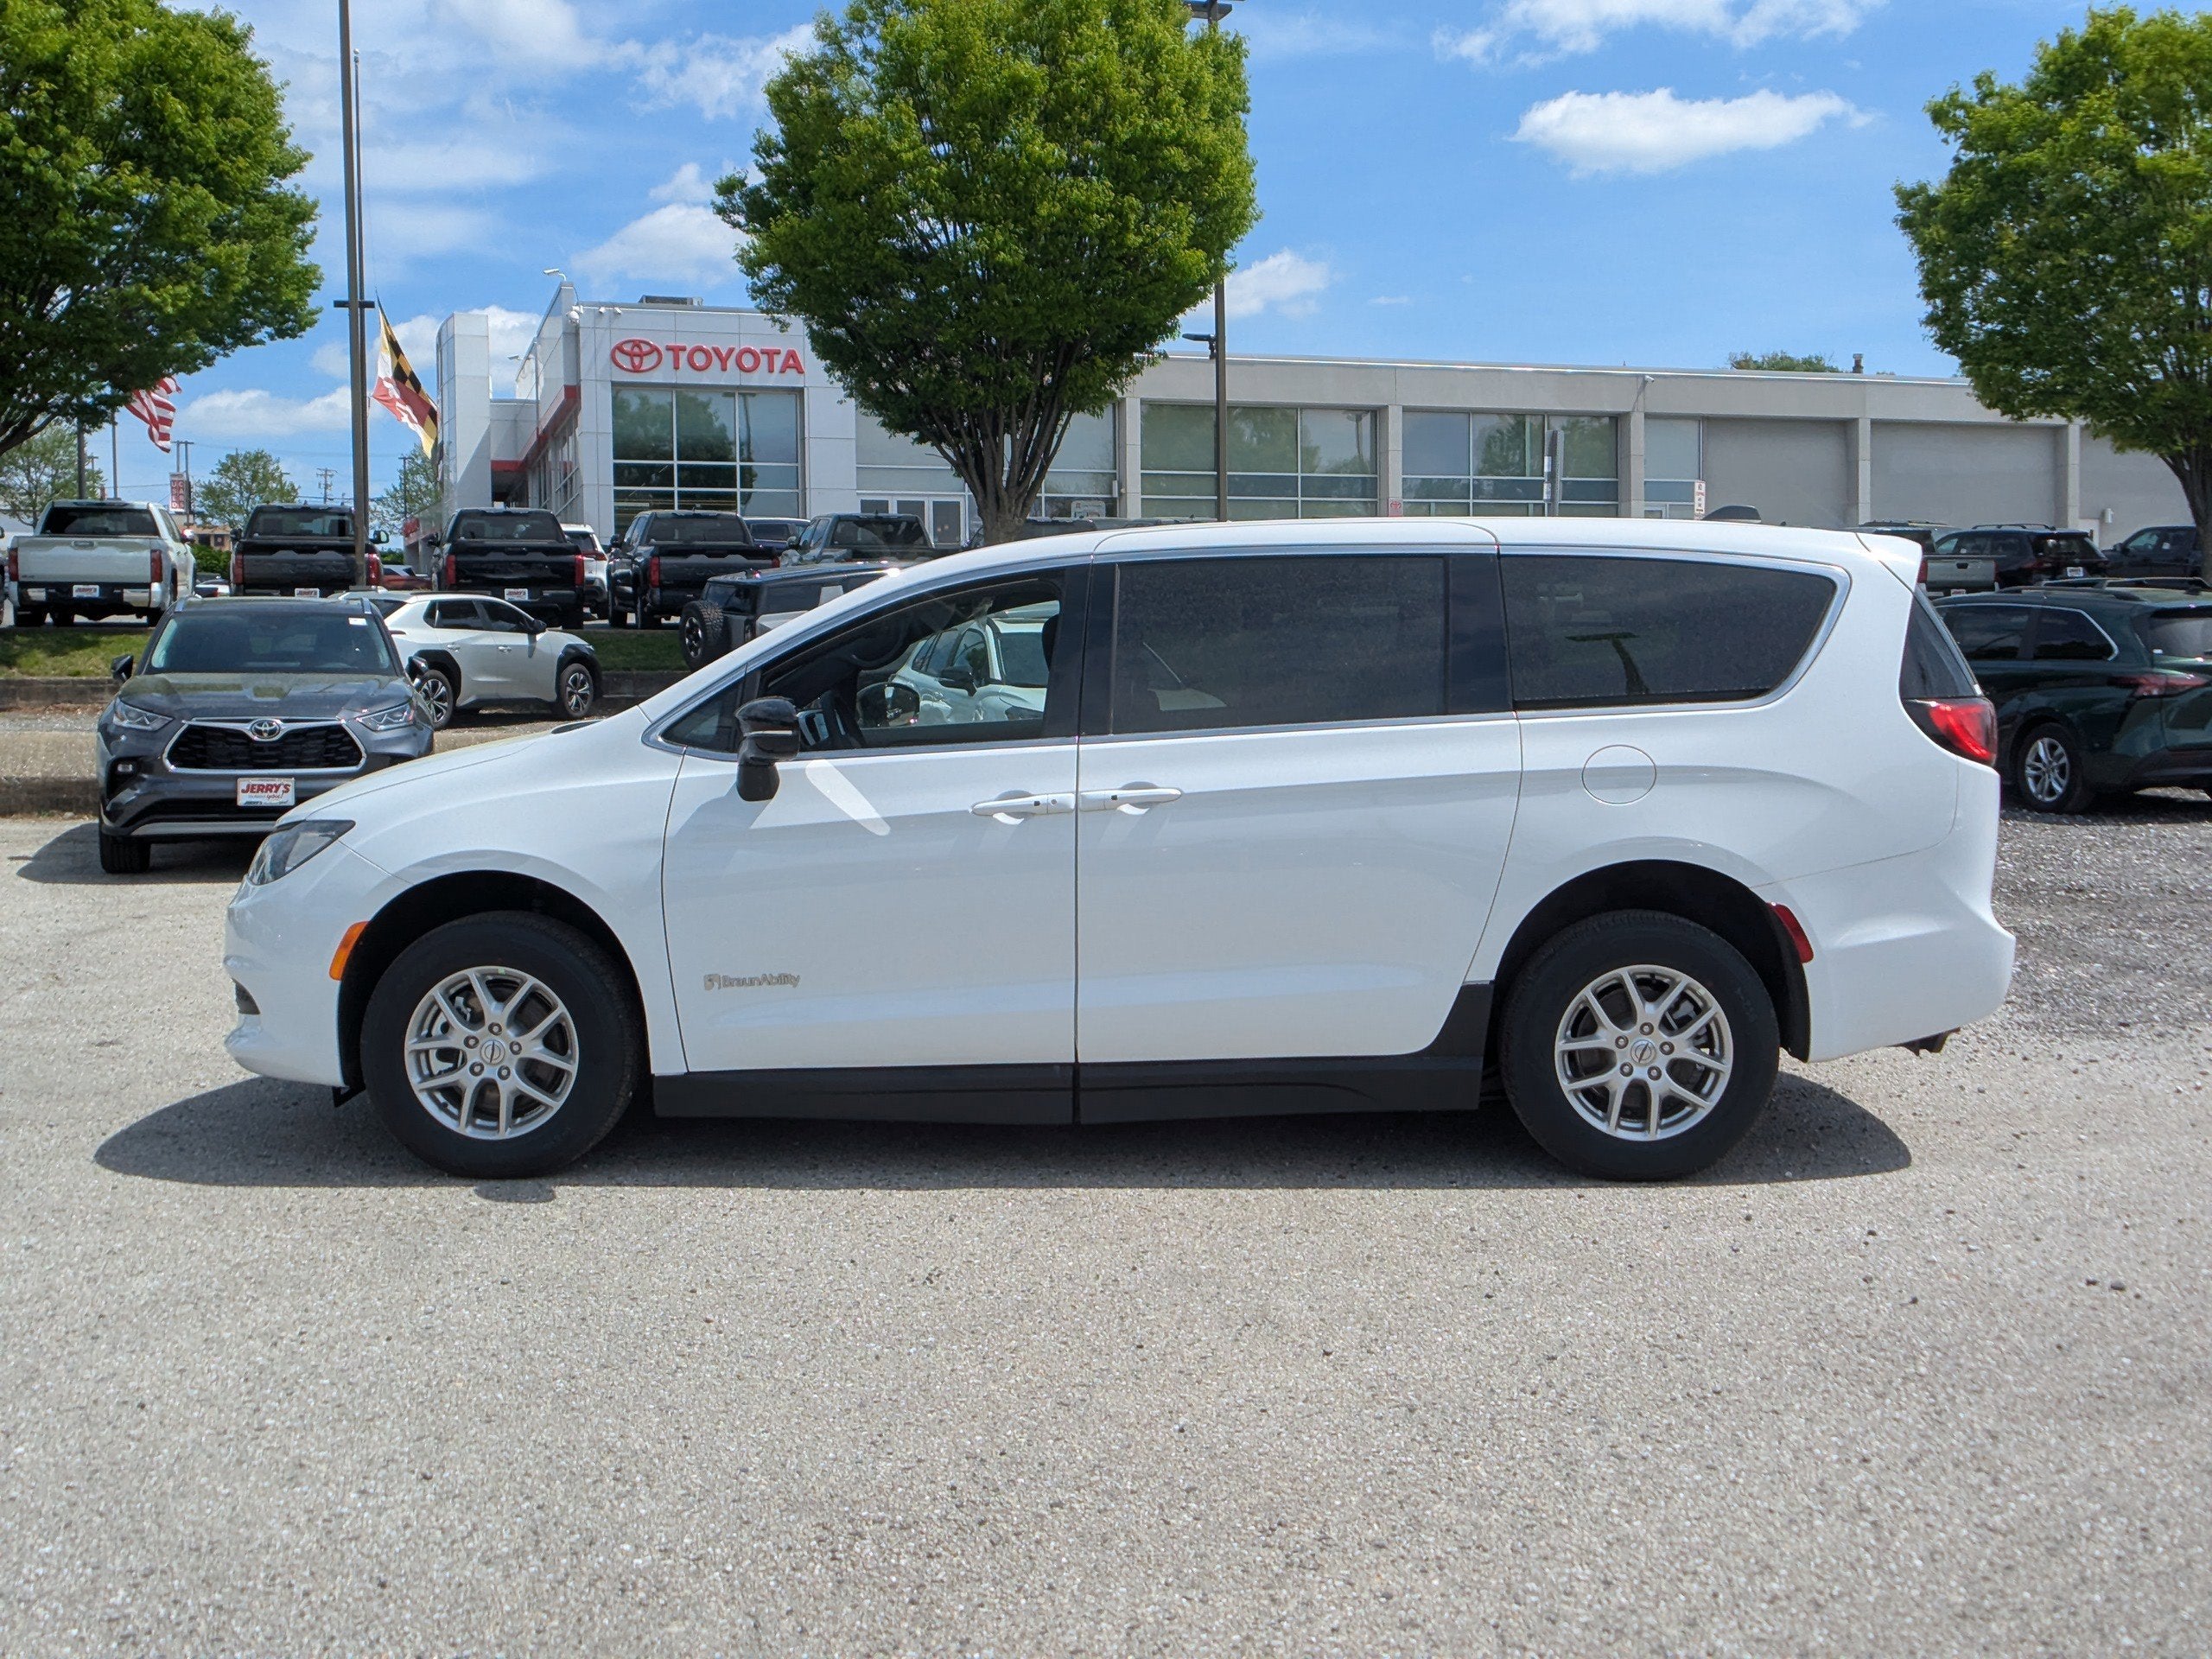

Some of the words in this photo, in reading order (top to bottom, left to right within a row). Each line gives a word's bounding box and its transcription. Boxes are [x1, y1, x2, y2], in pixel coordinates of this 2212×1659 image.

[666, 344, 805, 374] TOYOTA
[241, 783, 291, 793] JERRY'S
[721, 973, 801, 988] BraunAbility
